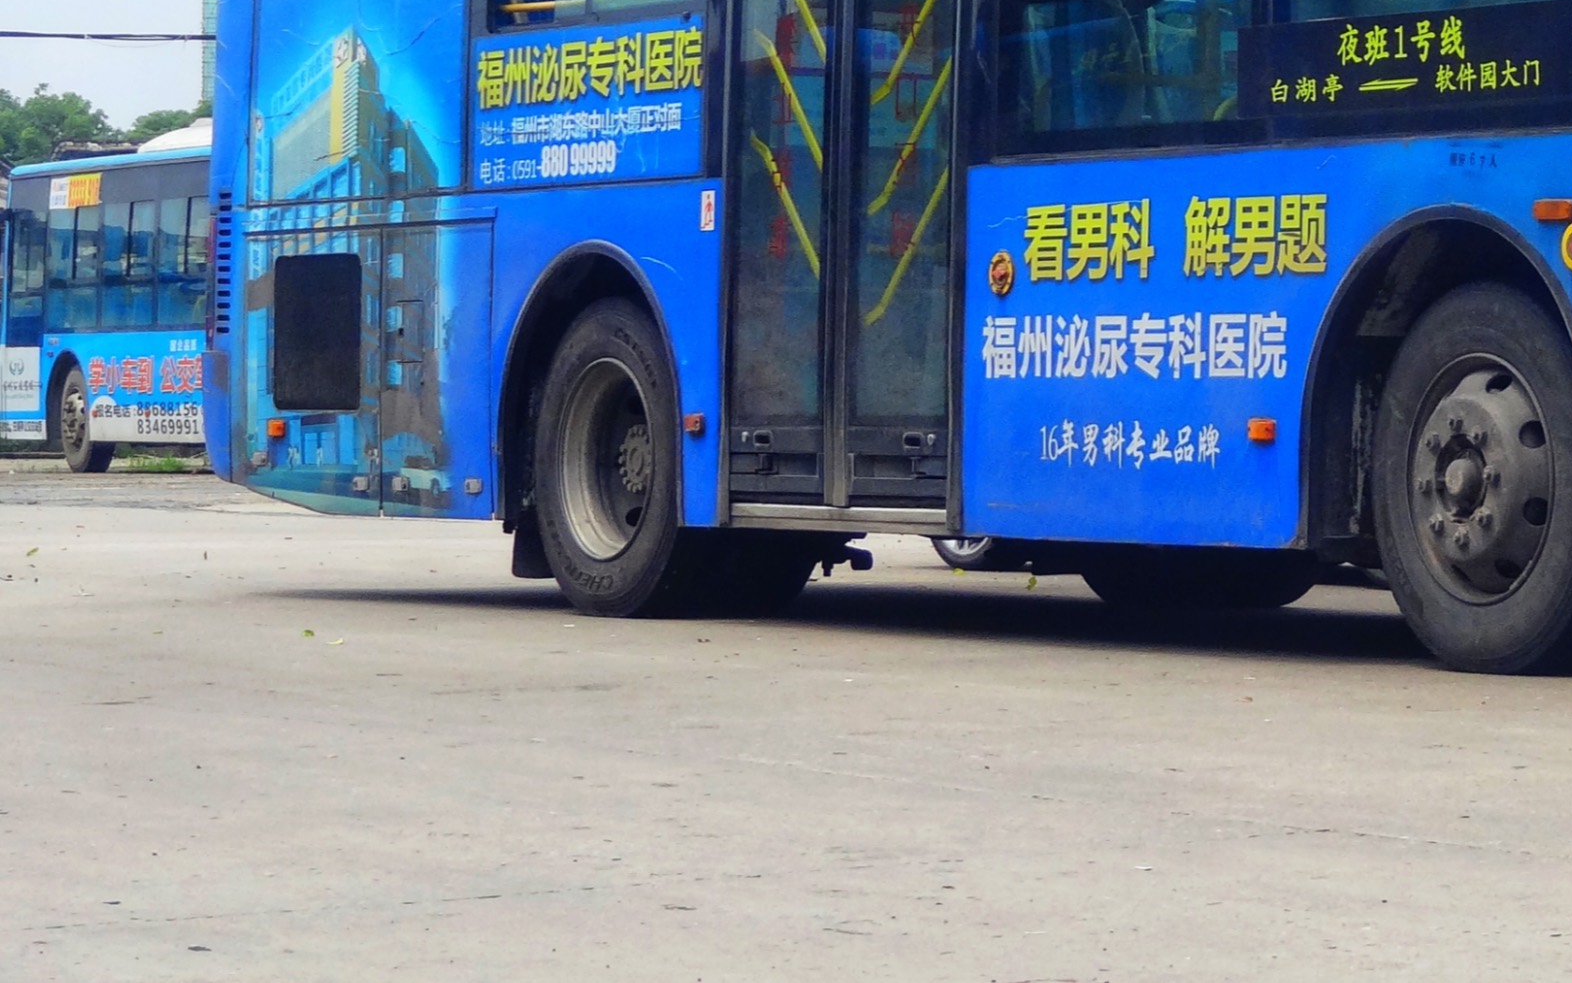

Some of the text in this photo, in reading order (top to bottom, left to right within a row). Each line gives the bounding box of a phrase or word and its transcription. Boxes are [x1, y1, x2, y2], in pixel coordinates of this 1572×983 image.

[1337, 15, 1466, 66] 夜班1号线
[477, 26, 703, 109] 福州泌尿专科医院
[1270, 59, 1541, 103] 白湖亭 软件园大门
[1023, 194, 1328, 282] 看男科 解男题
[982, 311, 1288, 380] 福州泌尿专科医院
[137, 418, 199, 435] 83469991
[1039, 418, 1221, 470] 16年男科专业品牌
